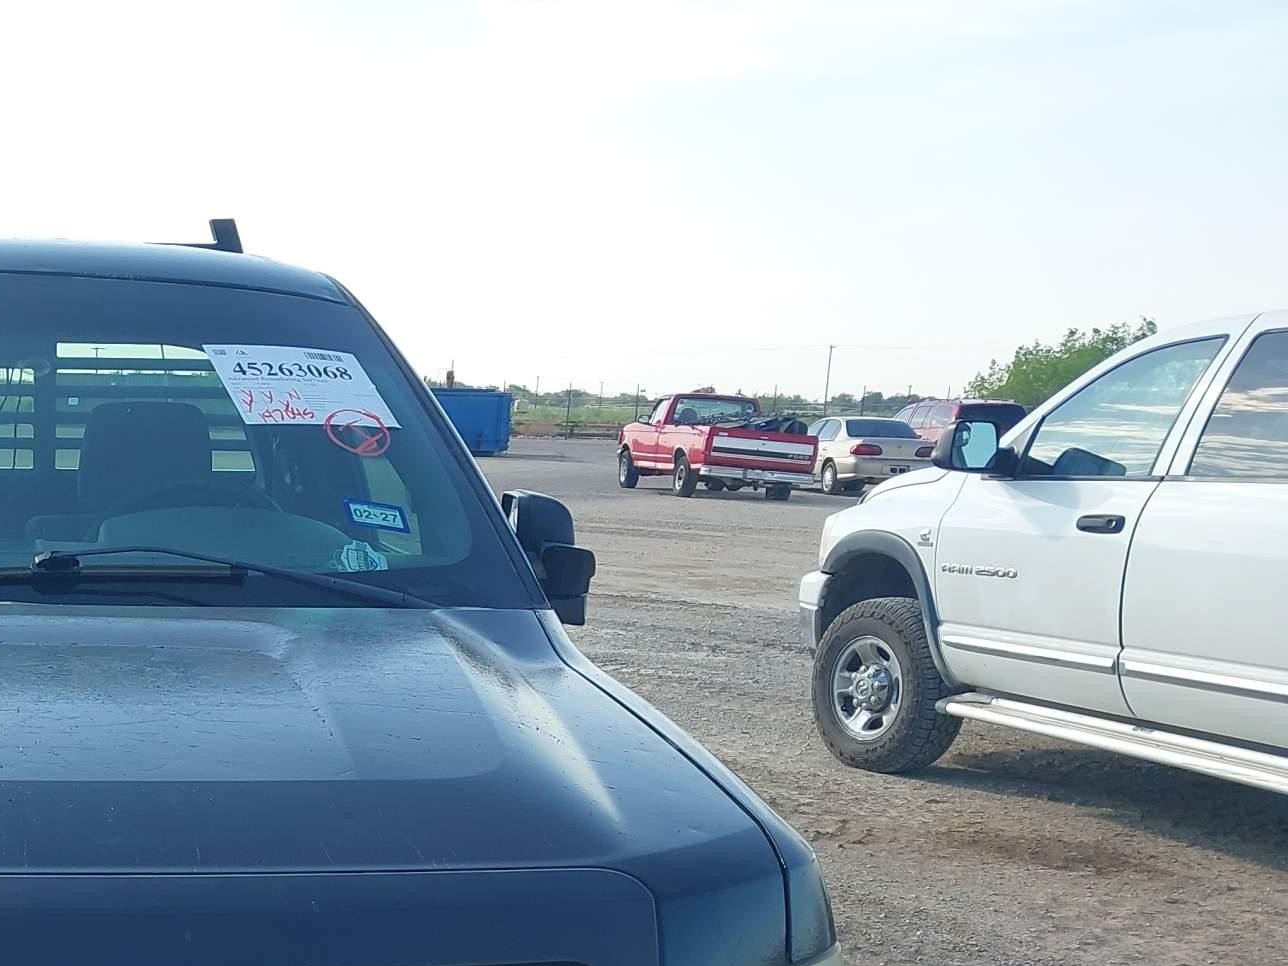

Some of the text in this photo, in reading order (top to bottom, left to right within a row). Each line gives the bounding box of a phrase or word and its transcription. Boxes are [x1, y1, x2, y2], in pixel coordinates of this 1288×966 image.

[232, 361, 353, 381] 45263068
[353, 508, 398, 523] 02-27
[942, 563, 1018, 579] RAM 2500
